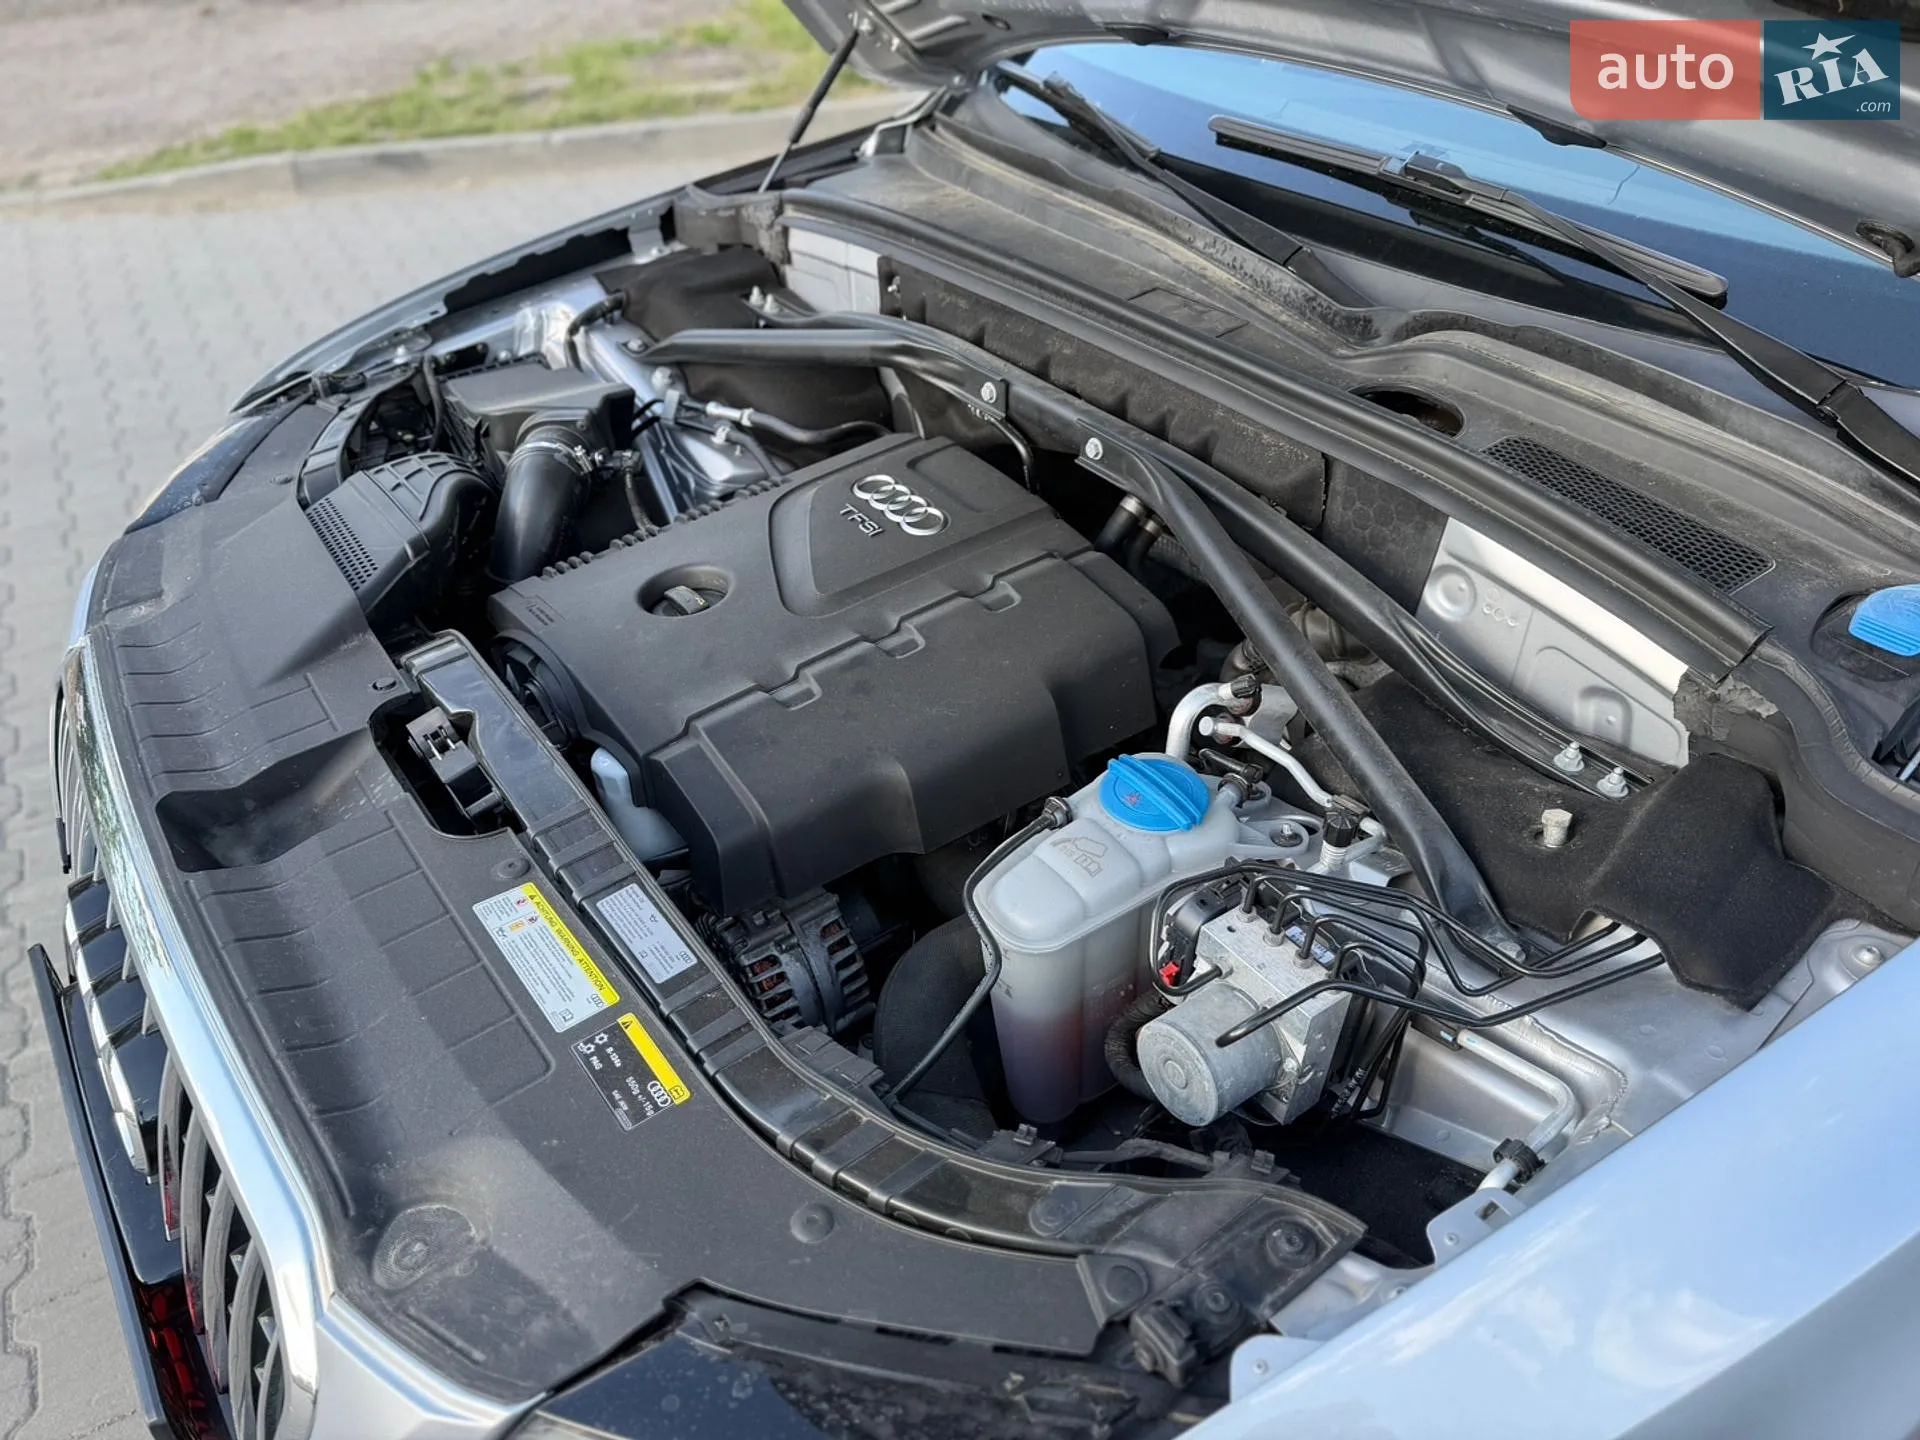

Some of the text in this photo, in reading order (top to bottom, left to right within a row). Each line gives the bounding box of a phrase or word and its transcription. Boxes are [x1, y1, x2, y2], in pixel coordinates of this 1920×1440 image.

[840, 503, 882, 536] TFSI
[555, 926, 579, 957] WARNING
[577, 957, 605, 991] ATTENTION
